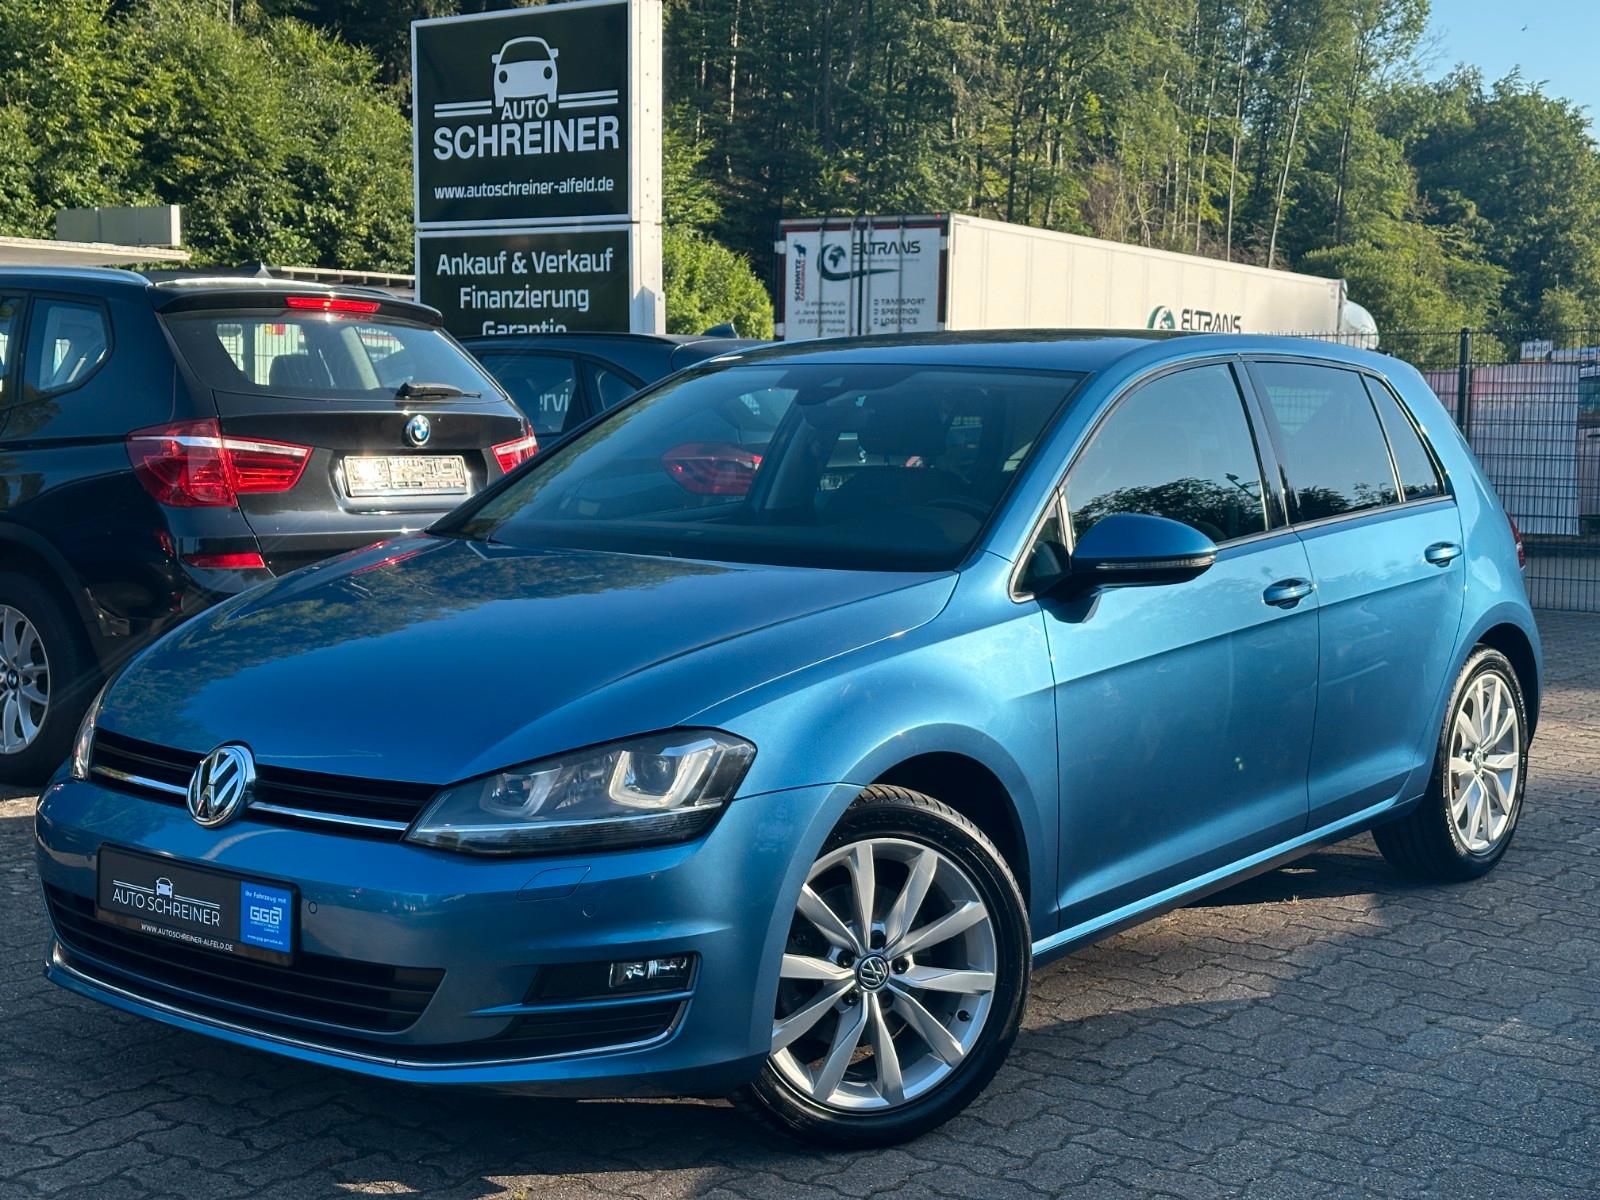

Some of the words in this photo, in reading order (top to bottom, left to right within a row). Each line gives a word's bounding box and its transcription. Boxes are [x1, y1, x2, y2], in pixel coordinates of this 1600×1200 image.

[501, 99, 548, 120] AUTO
[433, 115, 620, 161] SCHREINER
[434, 176, 614, 200] www.autoschreiner-alfeld.de
[436, 251, 507, 276] Ankauf
[511, 252, 528, 274] &
[531, 248, 614, 274] Verkauf
[459, 284, 590, 312] Finanzierung
[880, 307, 920, 315] SPEDTION
[1181, 308, 1242, 333] ELTRANS
[112, 888, 145, 908] AUTO
[147, 897, 220, 927] SCHREINER
[250, 906, 281, 925] GGG
[140, 924, 234, 951] WWW.AUTOSCHREINER-ALFELD.DE
